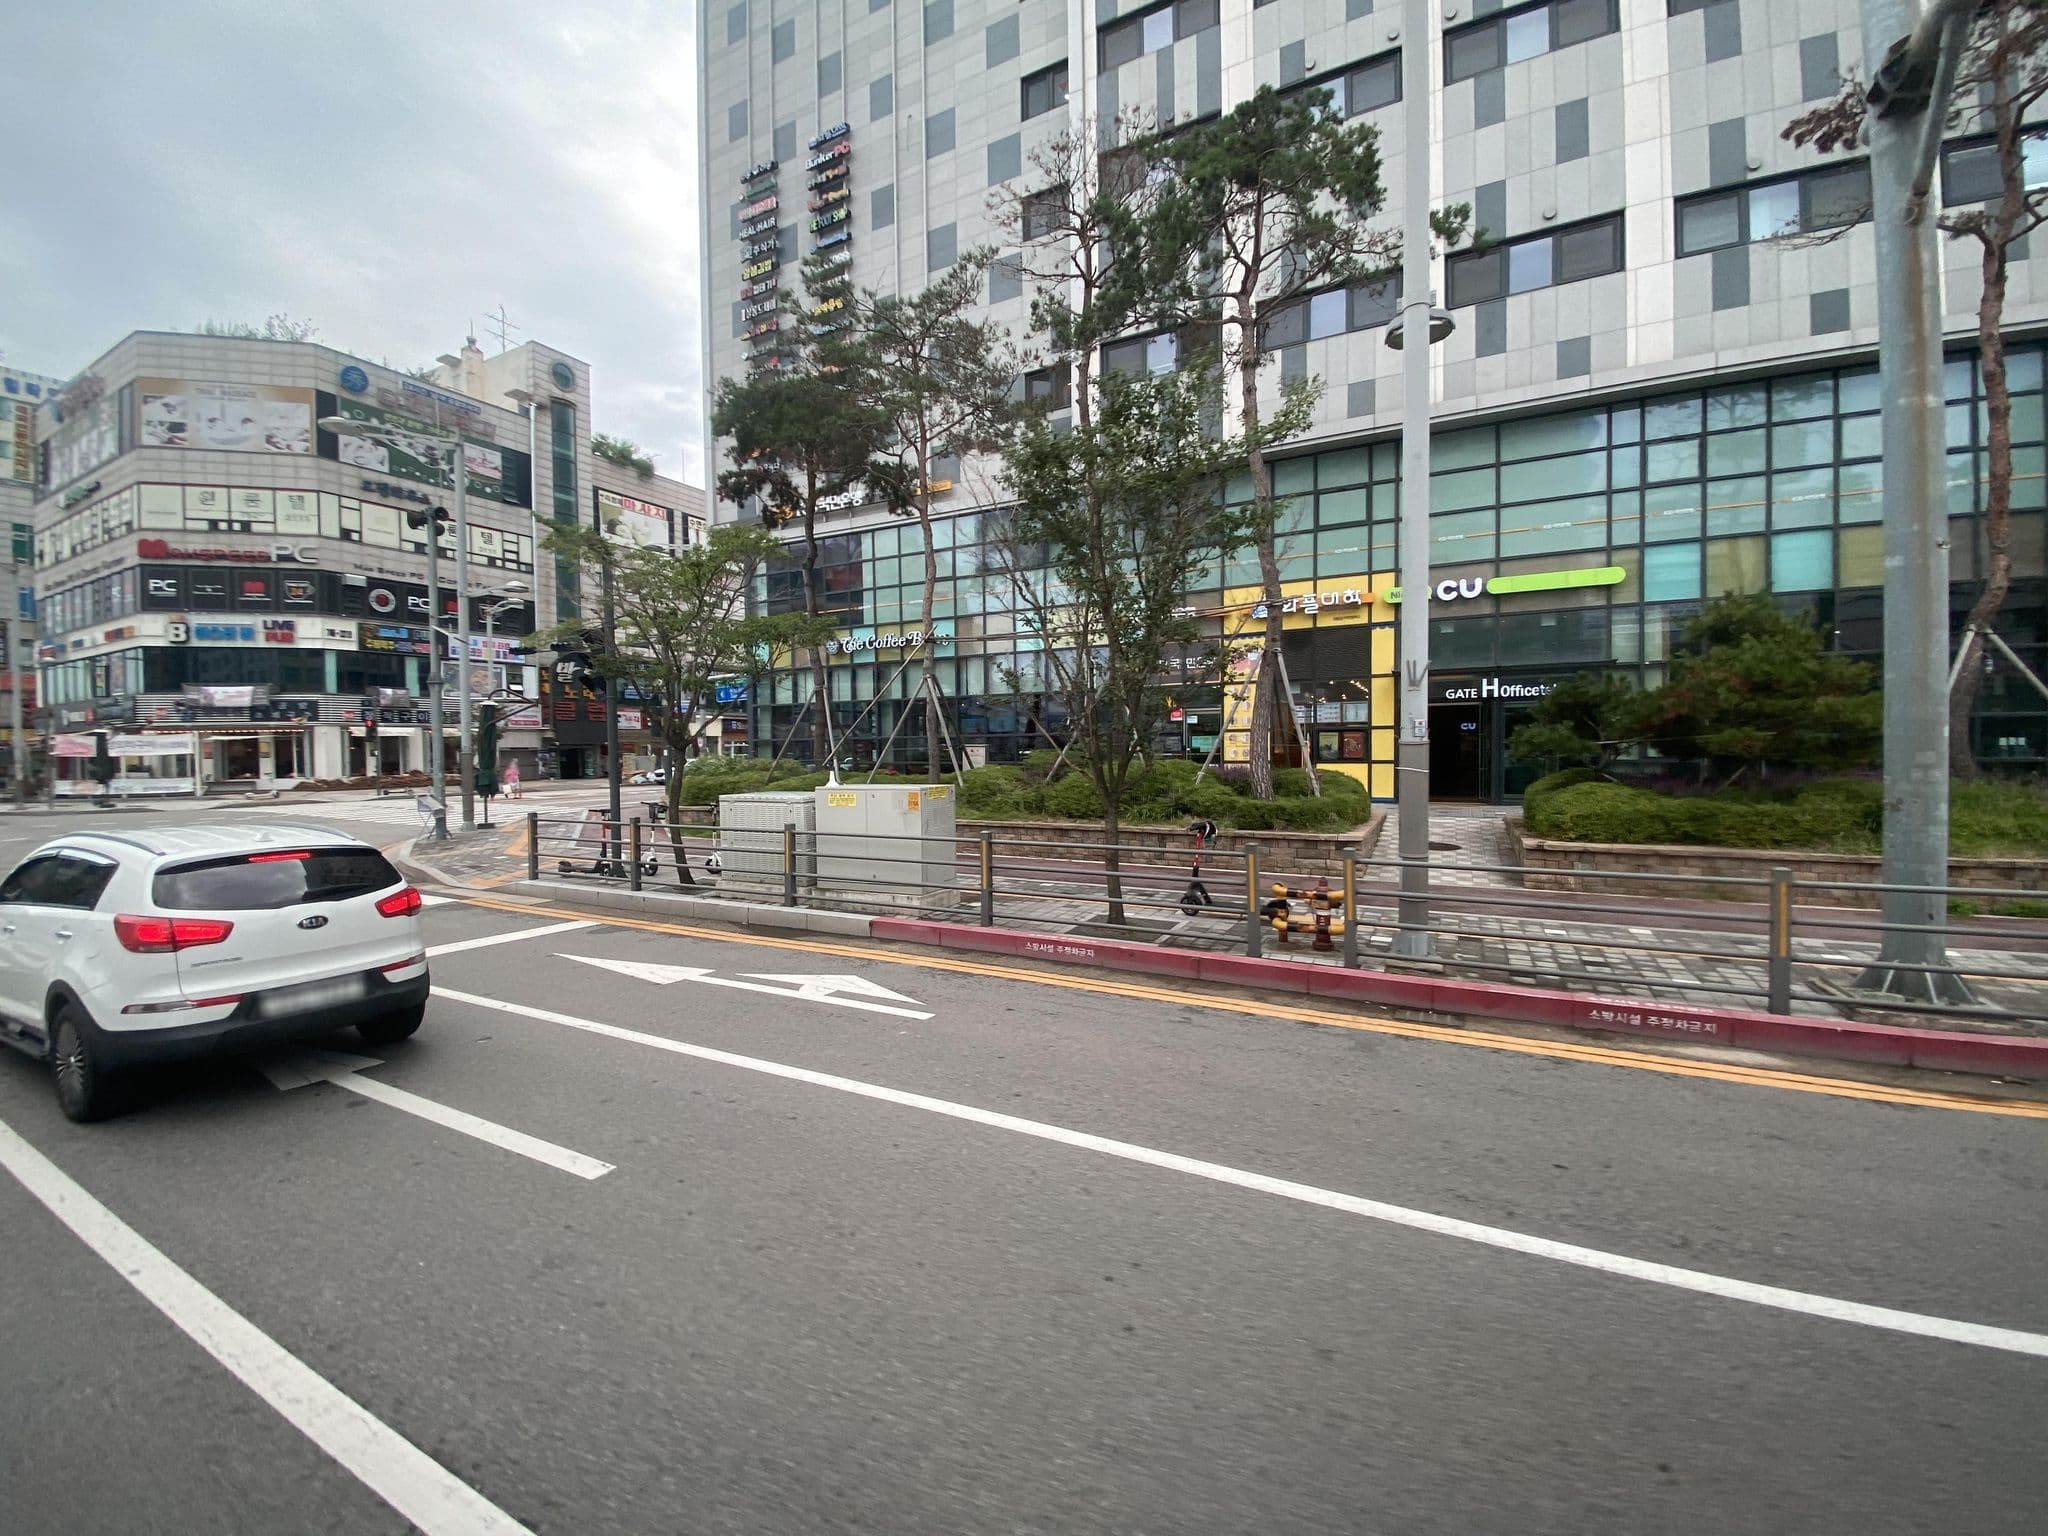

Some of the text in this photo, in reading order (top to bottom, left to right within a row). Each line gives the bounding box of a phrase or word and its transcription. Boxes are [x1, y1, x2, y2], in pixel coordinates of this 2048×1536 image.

[271, 543, 319, 564] PC
[1437, 577, 1482, 601] CU
[263, 620, 295, 631] LIVE
[841, 636, 865, 653] The
[866, 632, 906, 650] Coffee
[1445, 688, 1478, 699] GATE
[1461, 722, 1476, 730] CU
[1025, 942, 1094, 957] 소방시설 주정차금지
[1588, 1009, 1717, 1033] 소방시설 주정차금지
